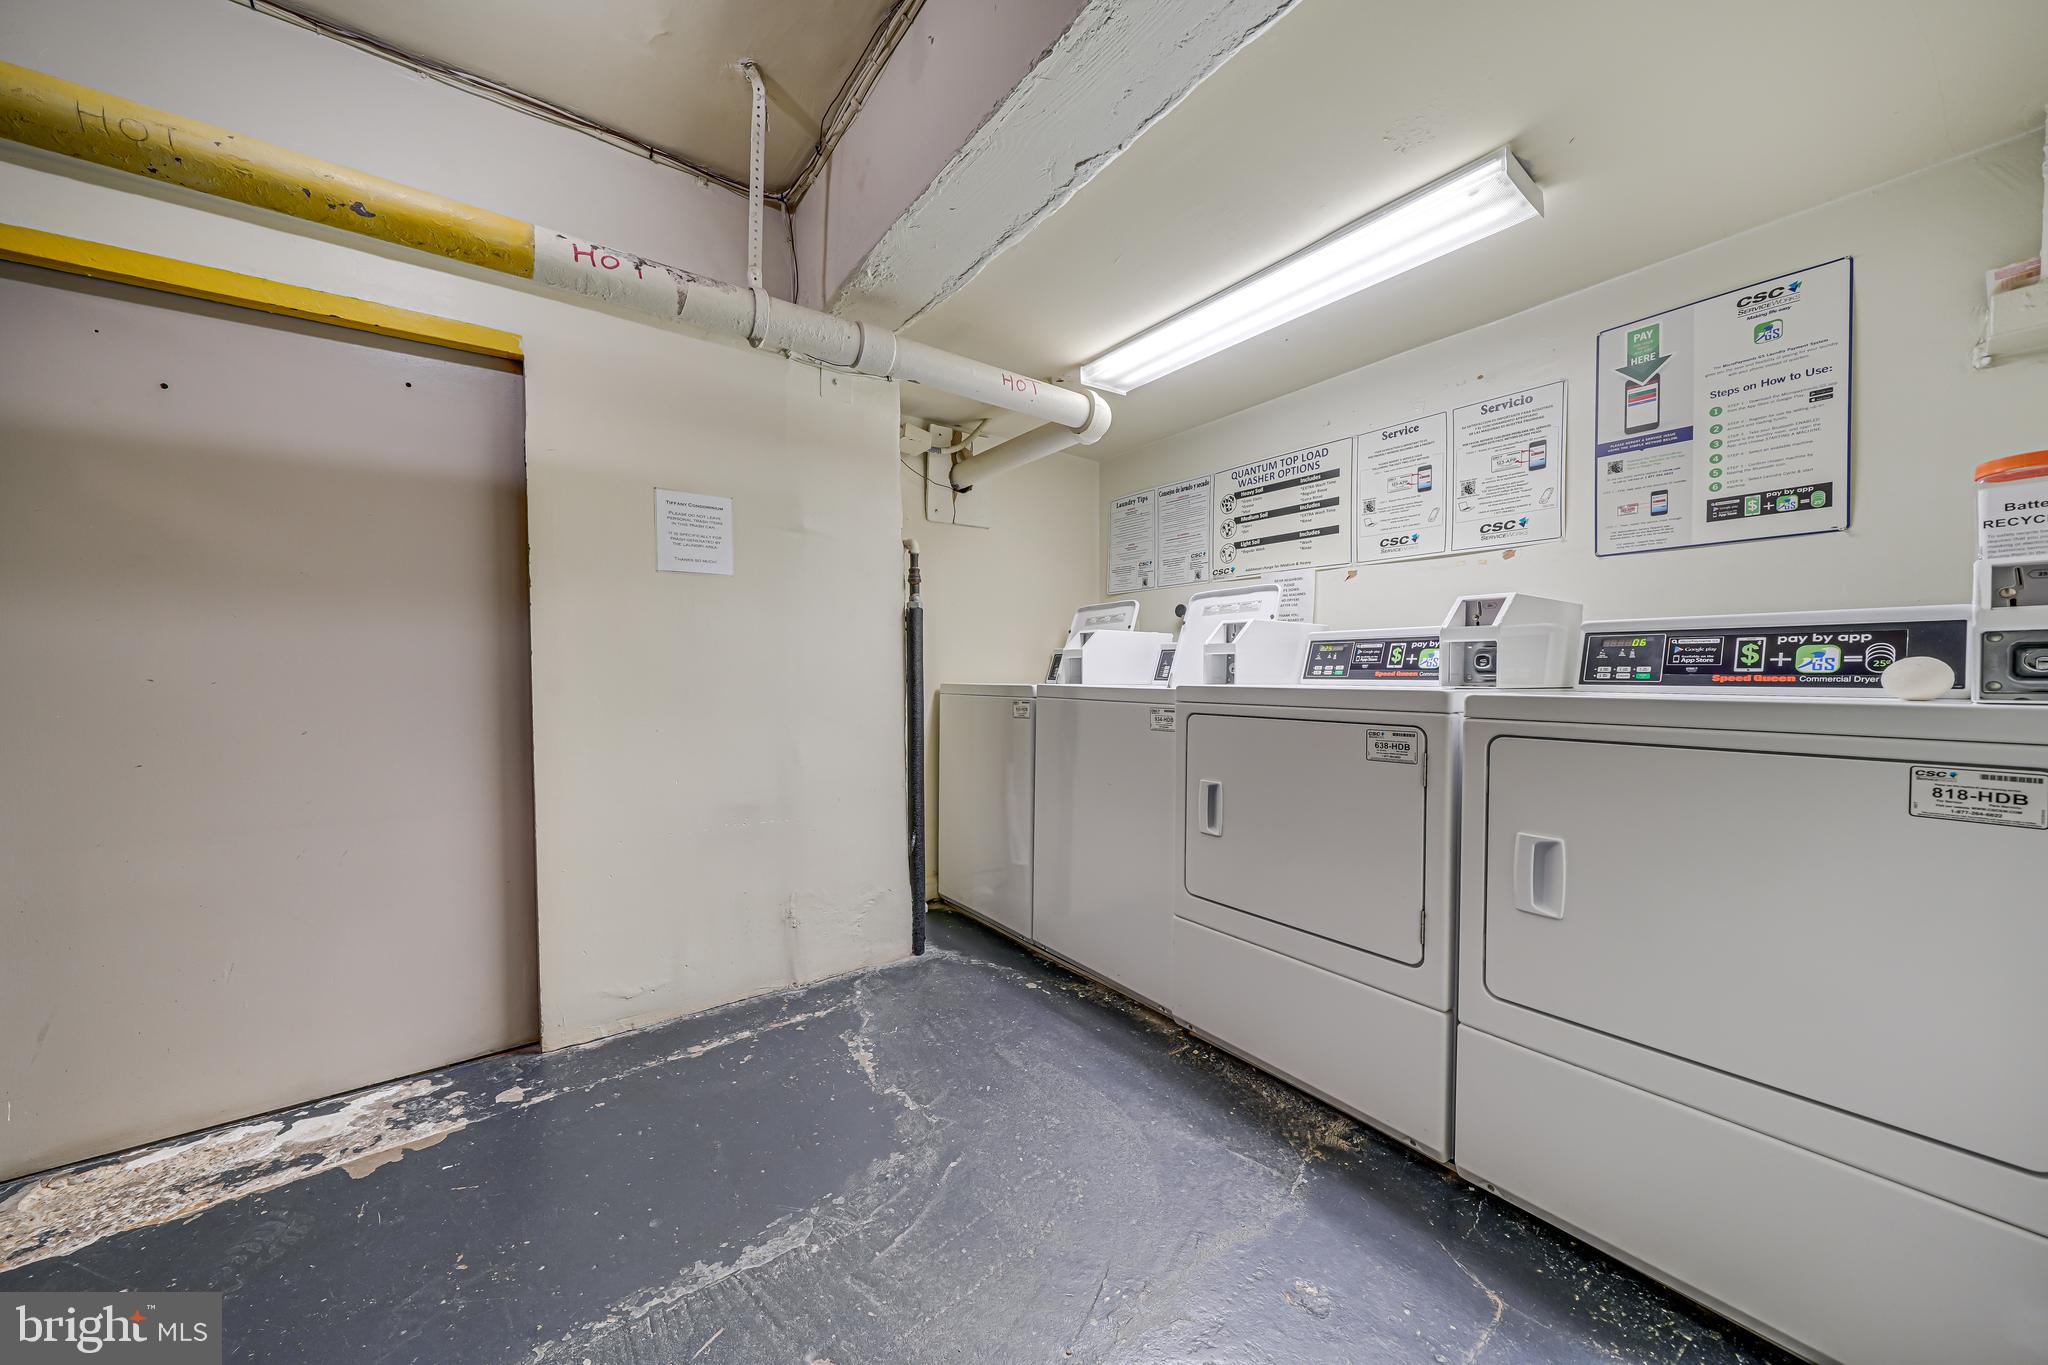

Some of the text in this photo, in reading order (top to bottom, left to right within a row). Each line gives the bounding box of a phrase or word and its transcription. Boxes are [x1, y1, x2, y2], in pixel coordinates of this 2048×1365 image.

[74, 99, 189, 152] HOT
[572, 243, 654, 280] HOT
[1736, 286, 1785, 308] CSC
[1747, 311, 1768, 321] Making
[1633, 329, 1654, 343] PAY
[1630, 352, 1656, 366] HERE
[1001, 372, 1041, 395] HOT
[1710, 366, 1833, 400] Steps on How to Use:
[1480, 395, 1534, 415] Servicio
[1382, 425, 1420, 441] Service
[1231, 447, 1329, 481] QUANTUM TOP LOAD
[1237, 461, 1320, 488] WASHER OPTIONS
[1240, 489, 1255, 498] Heavy
[1766, 486, 1814, 498] pay by app
[1116, 496, 1148, 509] Laundry Tips
[1240, 502, 1321, 522] Medium Soil Includes
[1480, 520, 1516, 534] CSC
[1983, 514, 2048, 529] RECYC
[1240, 540, 1252, 548] Light
[1300, 529, 1321, 538] Includes
[1380, 535, 1410, 548] CSC
[1212, 568, 1230, 576] CSC
[1411, 640, 1440, 649] pay by
[1777, 632, 1873, 645] pay by app
[1812, 657, 1836, 671] GS
[1711, 674, 1880, 685] Speed Queen Commercial Dryer
[1374, 741, 1411, 751] 638-HDB
[1915, 769, 1948, 778] CSC
[1932, 787, 2029, 806] 818-HDB
